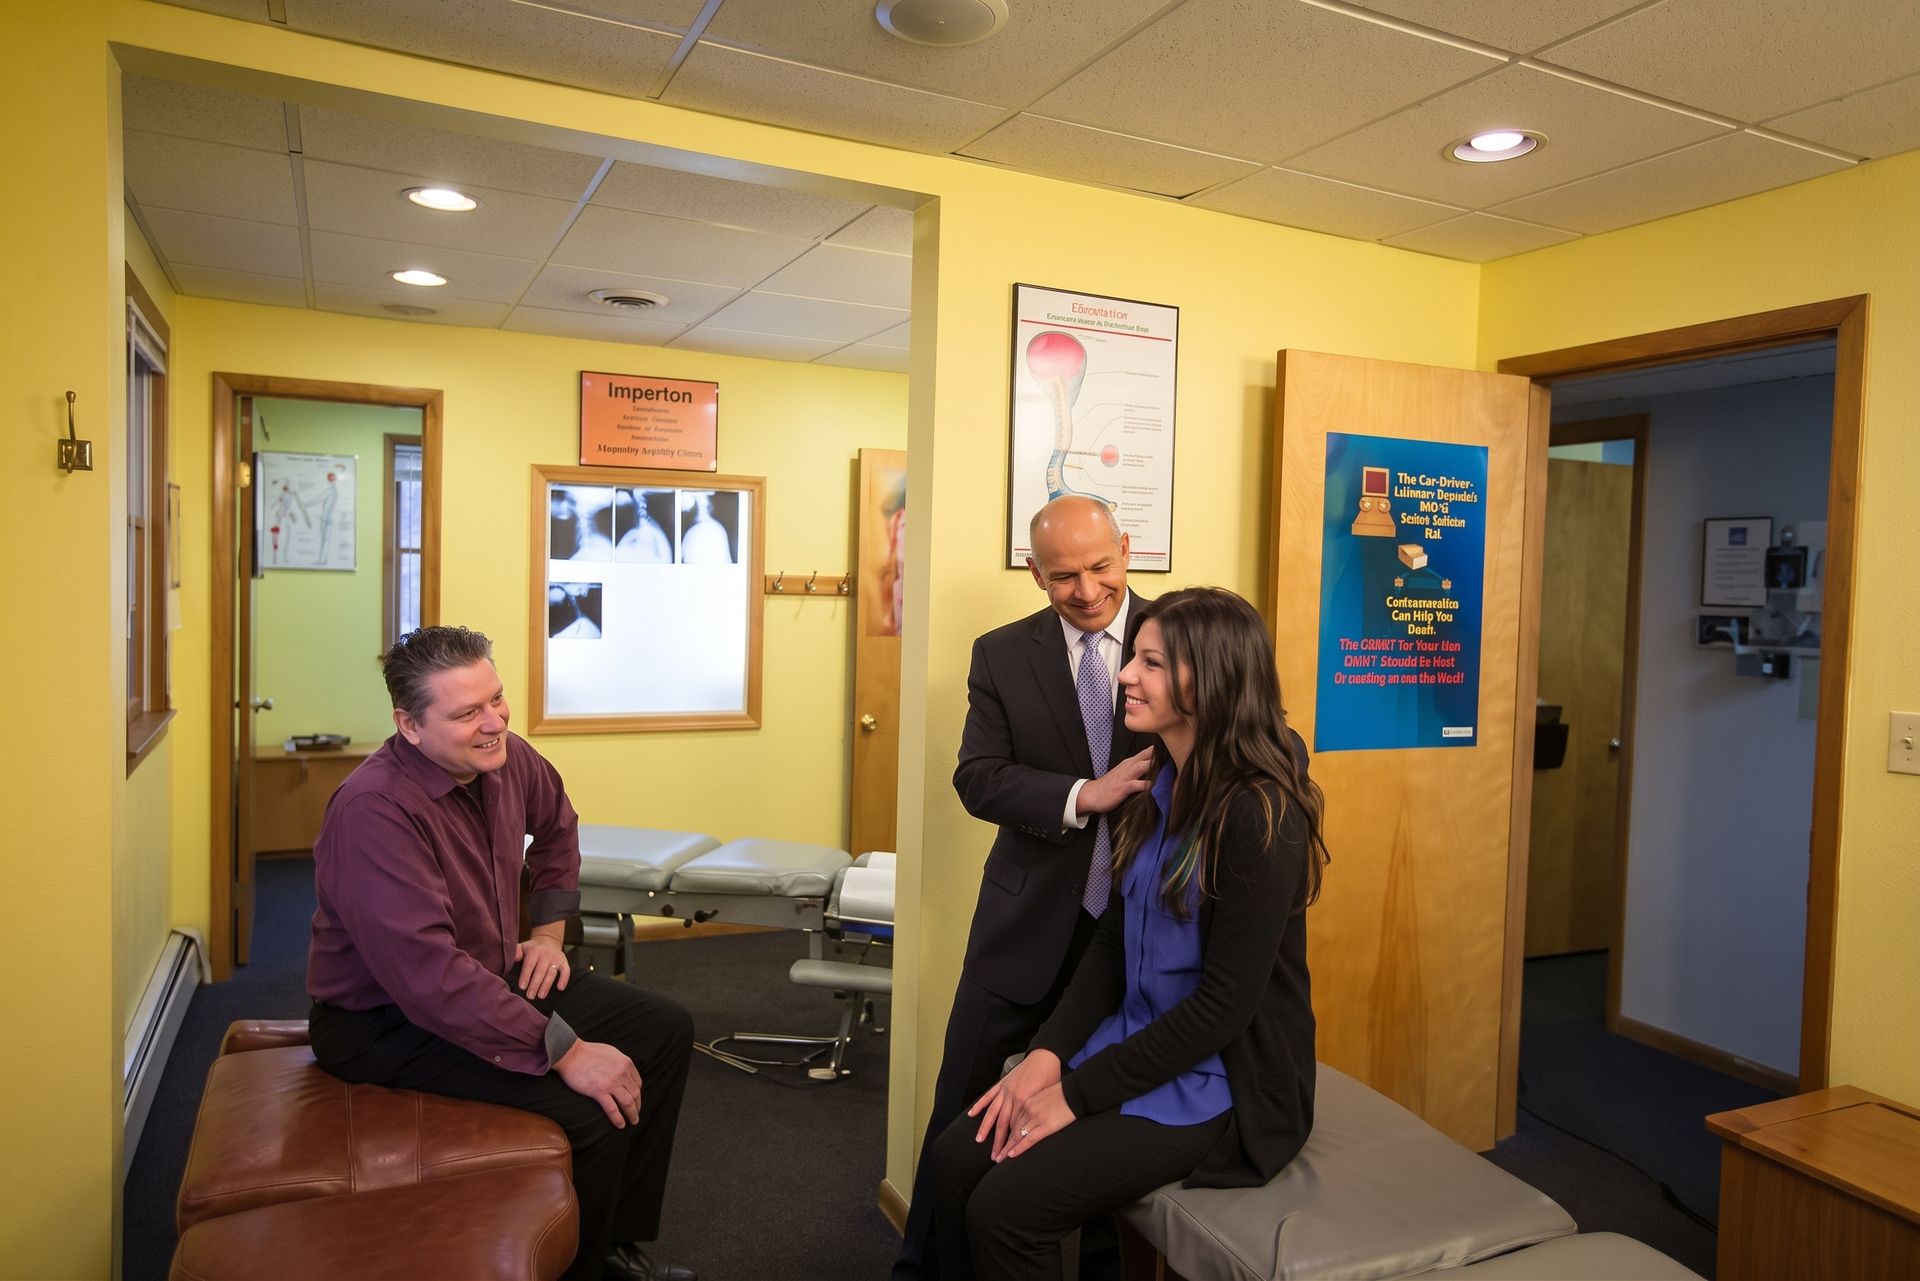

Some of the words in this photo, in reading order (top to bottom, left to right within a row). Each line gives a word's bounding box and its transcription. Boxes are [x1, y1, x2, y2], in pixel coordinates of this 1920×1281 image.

[608, 382, 692, 403] Imperton
[1397, 472, 1417, 485] The
[1391, 610, 1411, 621] Can
[1436, 611, 1453, 622] You
[1339, 638, 1359, 650] The
[1415, 639, 1440, 651] Your
[1334, 672, 1348, 684] Or
[1419, 671, 1436, 684] the
